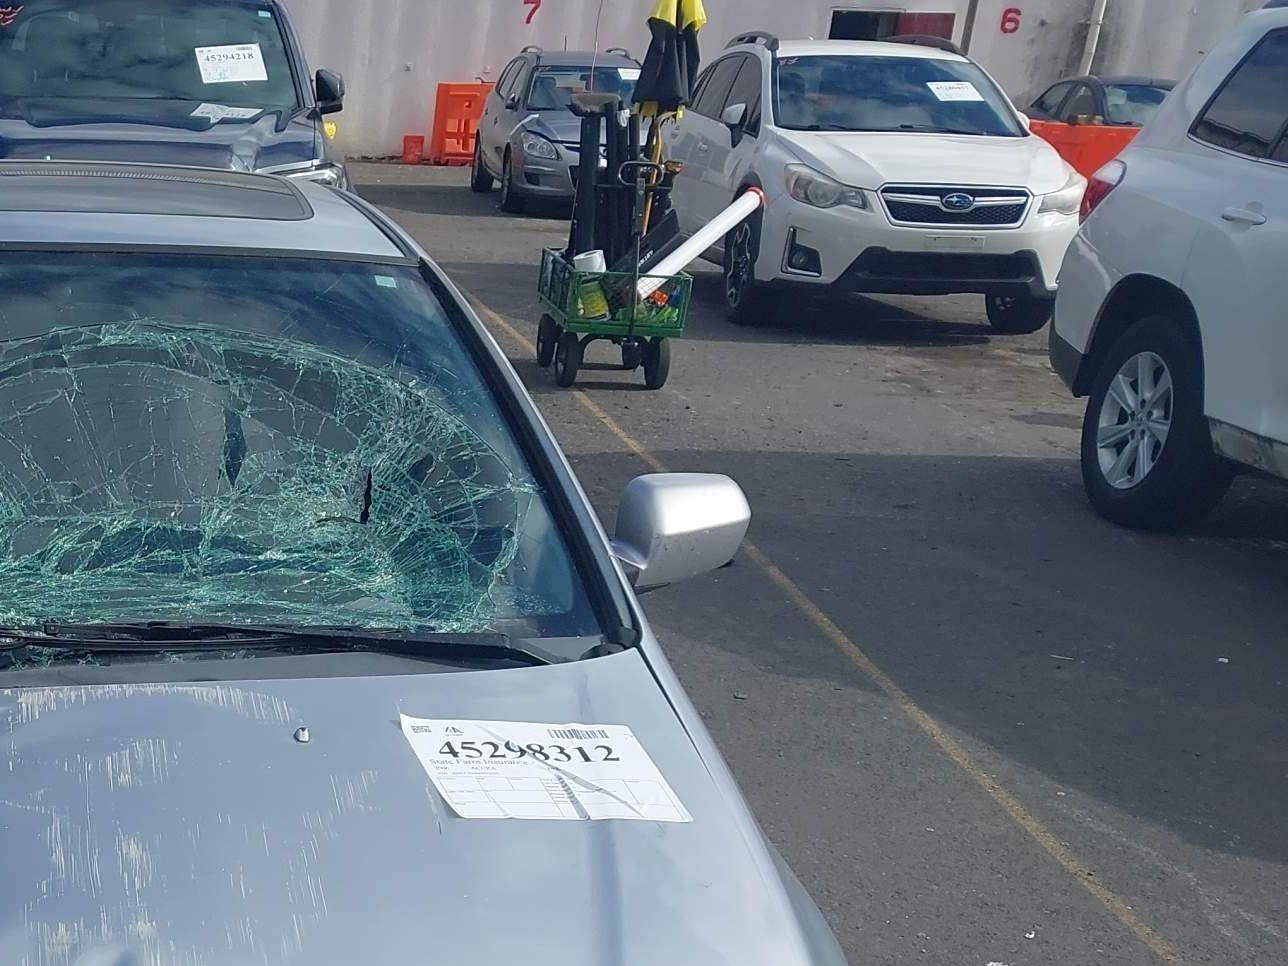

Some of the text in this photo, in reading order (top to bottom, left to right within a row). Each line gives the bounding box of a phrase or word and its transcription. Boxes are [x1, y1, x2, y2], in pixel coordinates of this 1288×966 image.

[523, 0, 542, 25] 7
[999, 7, 1022, 34] 6
[439, 740, 620, 762] 45298312
